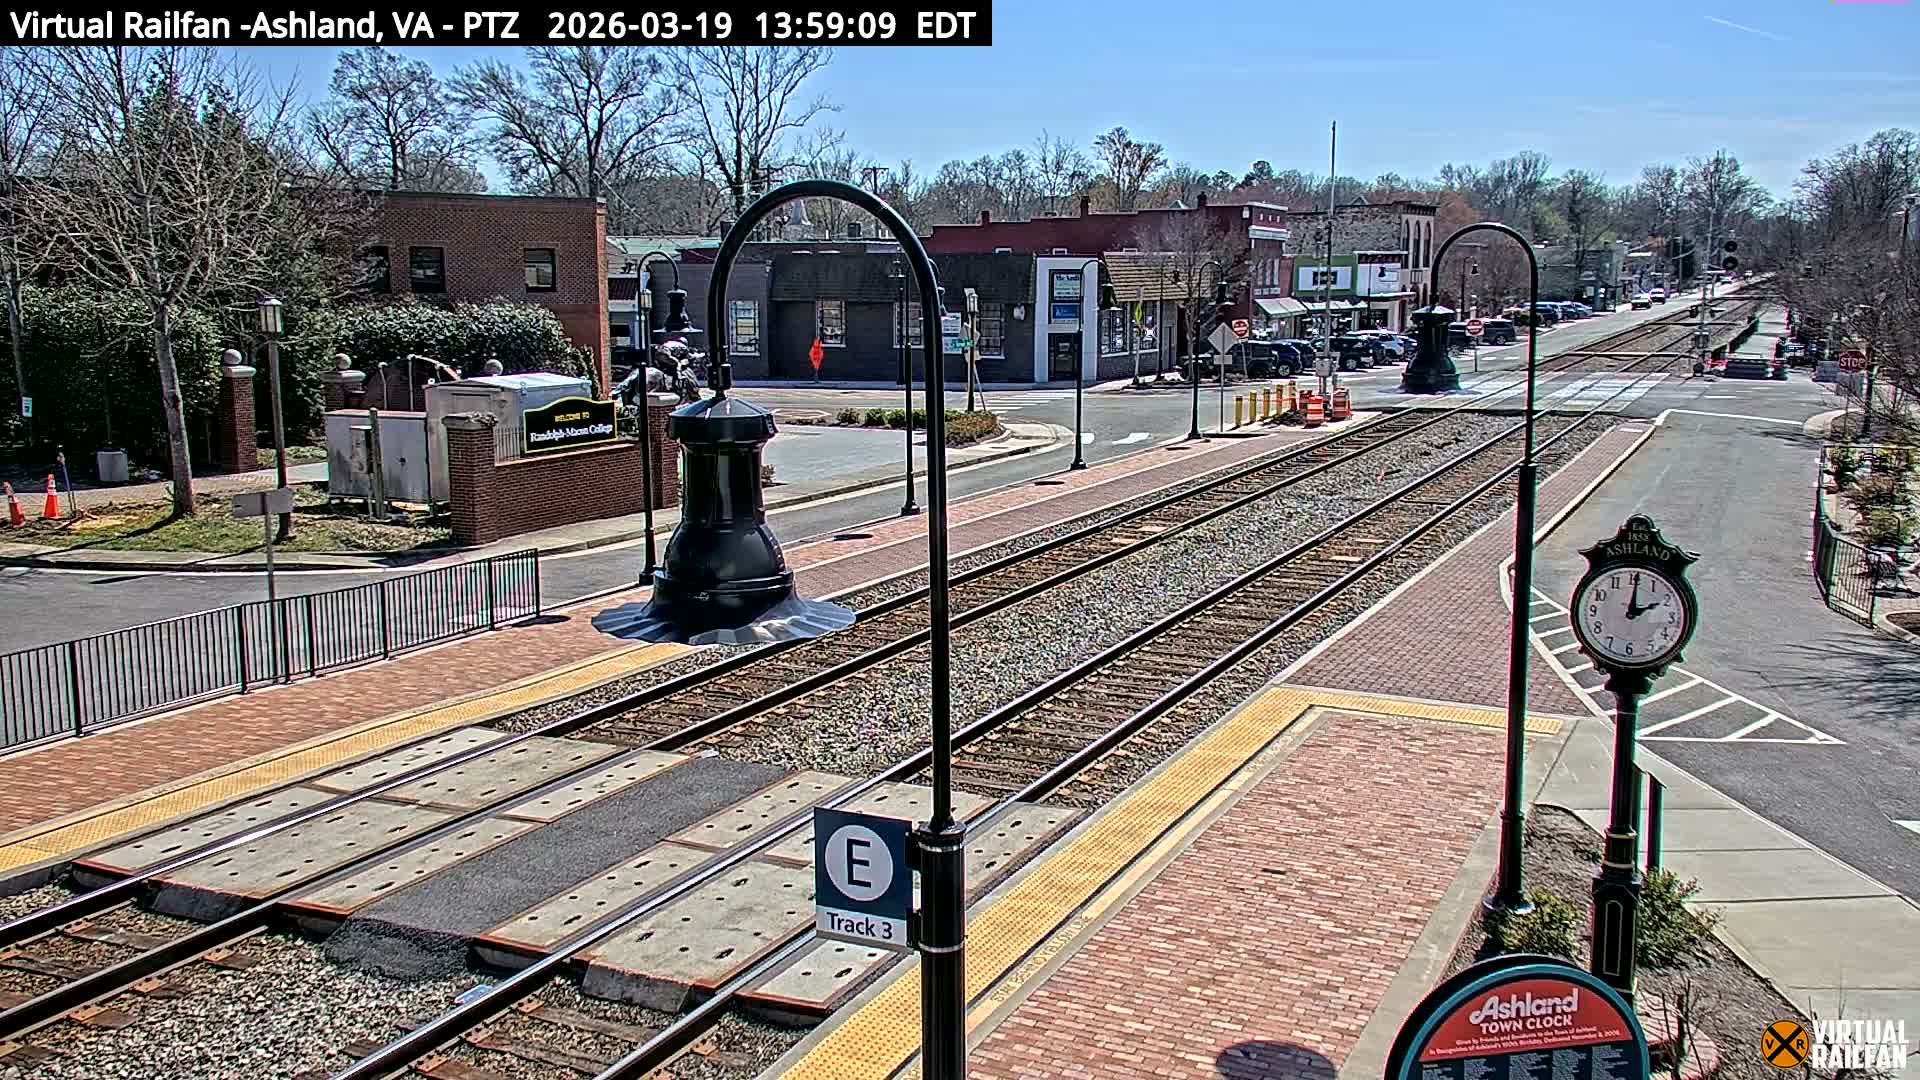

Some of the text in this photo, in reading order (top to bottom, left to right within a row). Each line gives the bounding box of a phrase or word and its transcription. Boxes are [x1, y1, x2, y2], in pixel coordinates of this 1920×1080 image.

[1840, 357, 1866, 368] STOP
[589, 424, 613, 434] College
[1606, 543, 1671, 561] ASHLAND
[1611, 577, 1621, 590] 11
[1594, 589, 1607, 602] 10
[1663, 594, 1672, 607] 2
[1589, 605, 1598, 618] 9
[1668, 612, 1676, 625] 3
[1593, 621, 1603, 635] 8
[1660, 627, 1669, 641] 4
[1606, 636, 1614, 649] 7
[1625, 642, 1634, 656] 6
[1648, 640, 1657, 651] 5
[847, 838, 872, 888] E
[827, 912, 893, 940] Track 3
[1469, 988, 1578, 1025] Ashland
[1480, 1014, 1573, 1035] TOWN CLOCK
